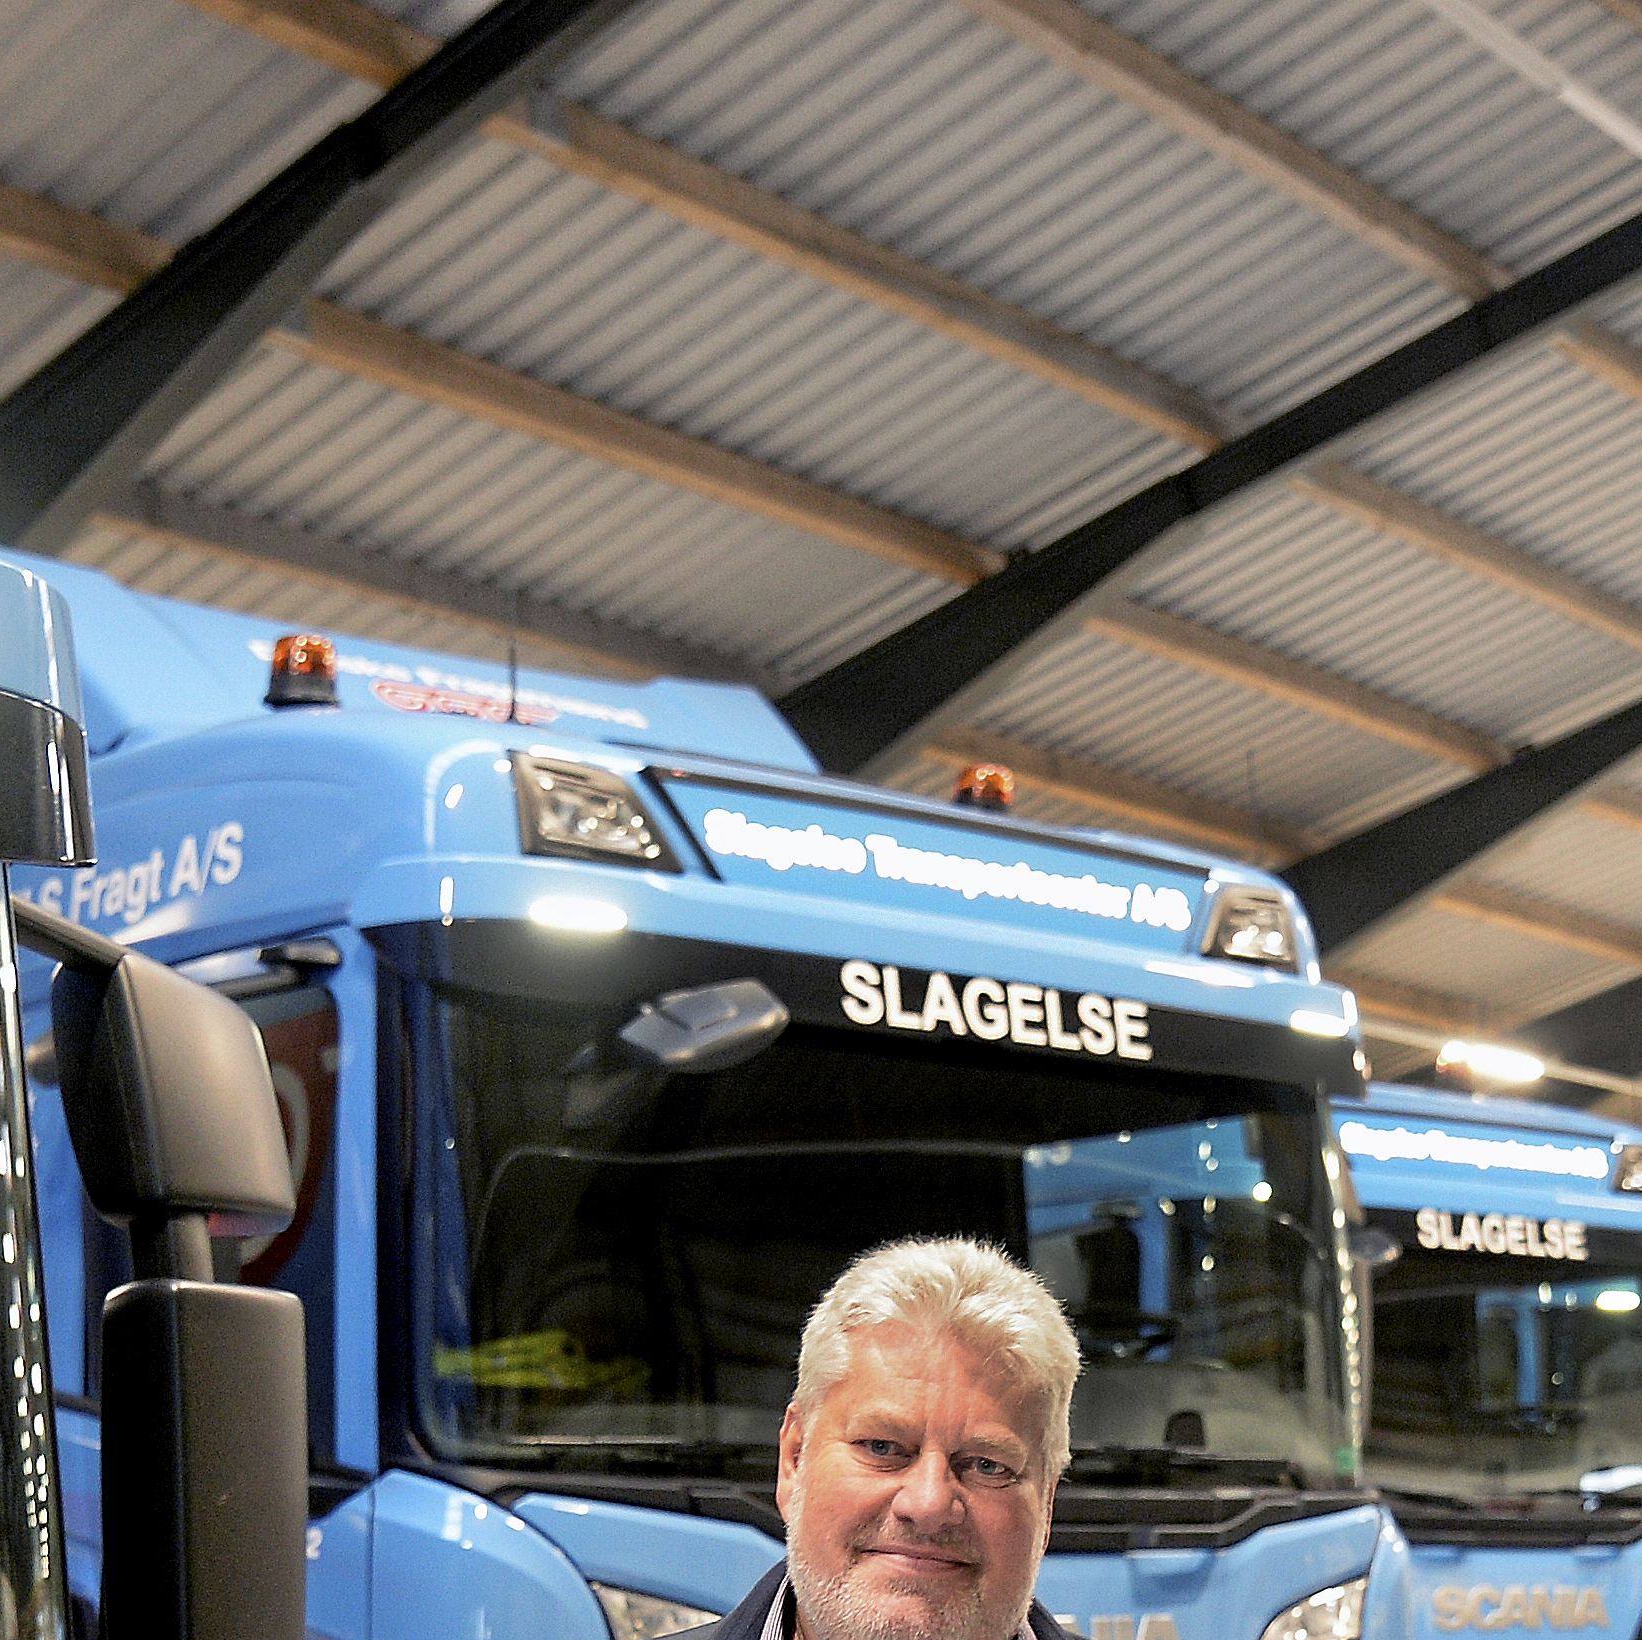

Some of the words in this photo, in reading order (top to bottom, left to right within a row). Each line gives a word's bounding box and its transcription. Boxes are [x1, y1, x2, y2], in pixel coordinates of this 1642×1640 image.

[68, 850, 165, 924] Fragt
[169, 822, 245, 897] A/S
[839, 959, 1153, 1061] SLAGELSE
[1417, 1207, 1589, 1261] SLAGELSE
[1432, 1584, 1610, 1631] SCANIA
